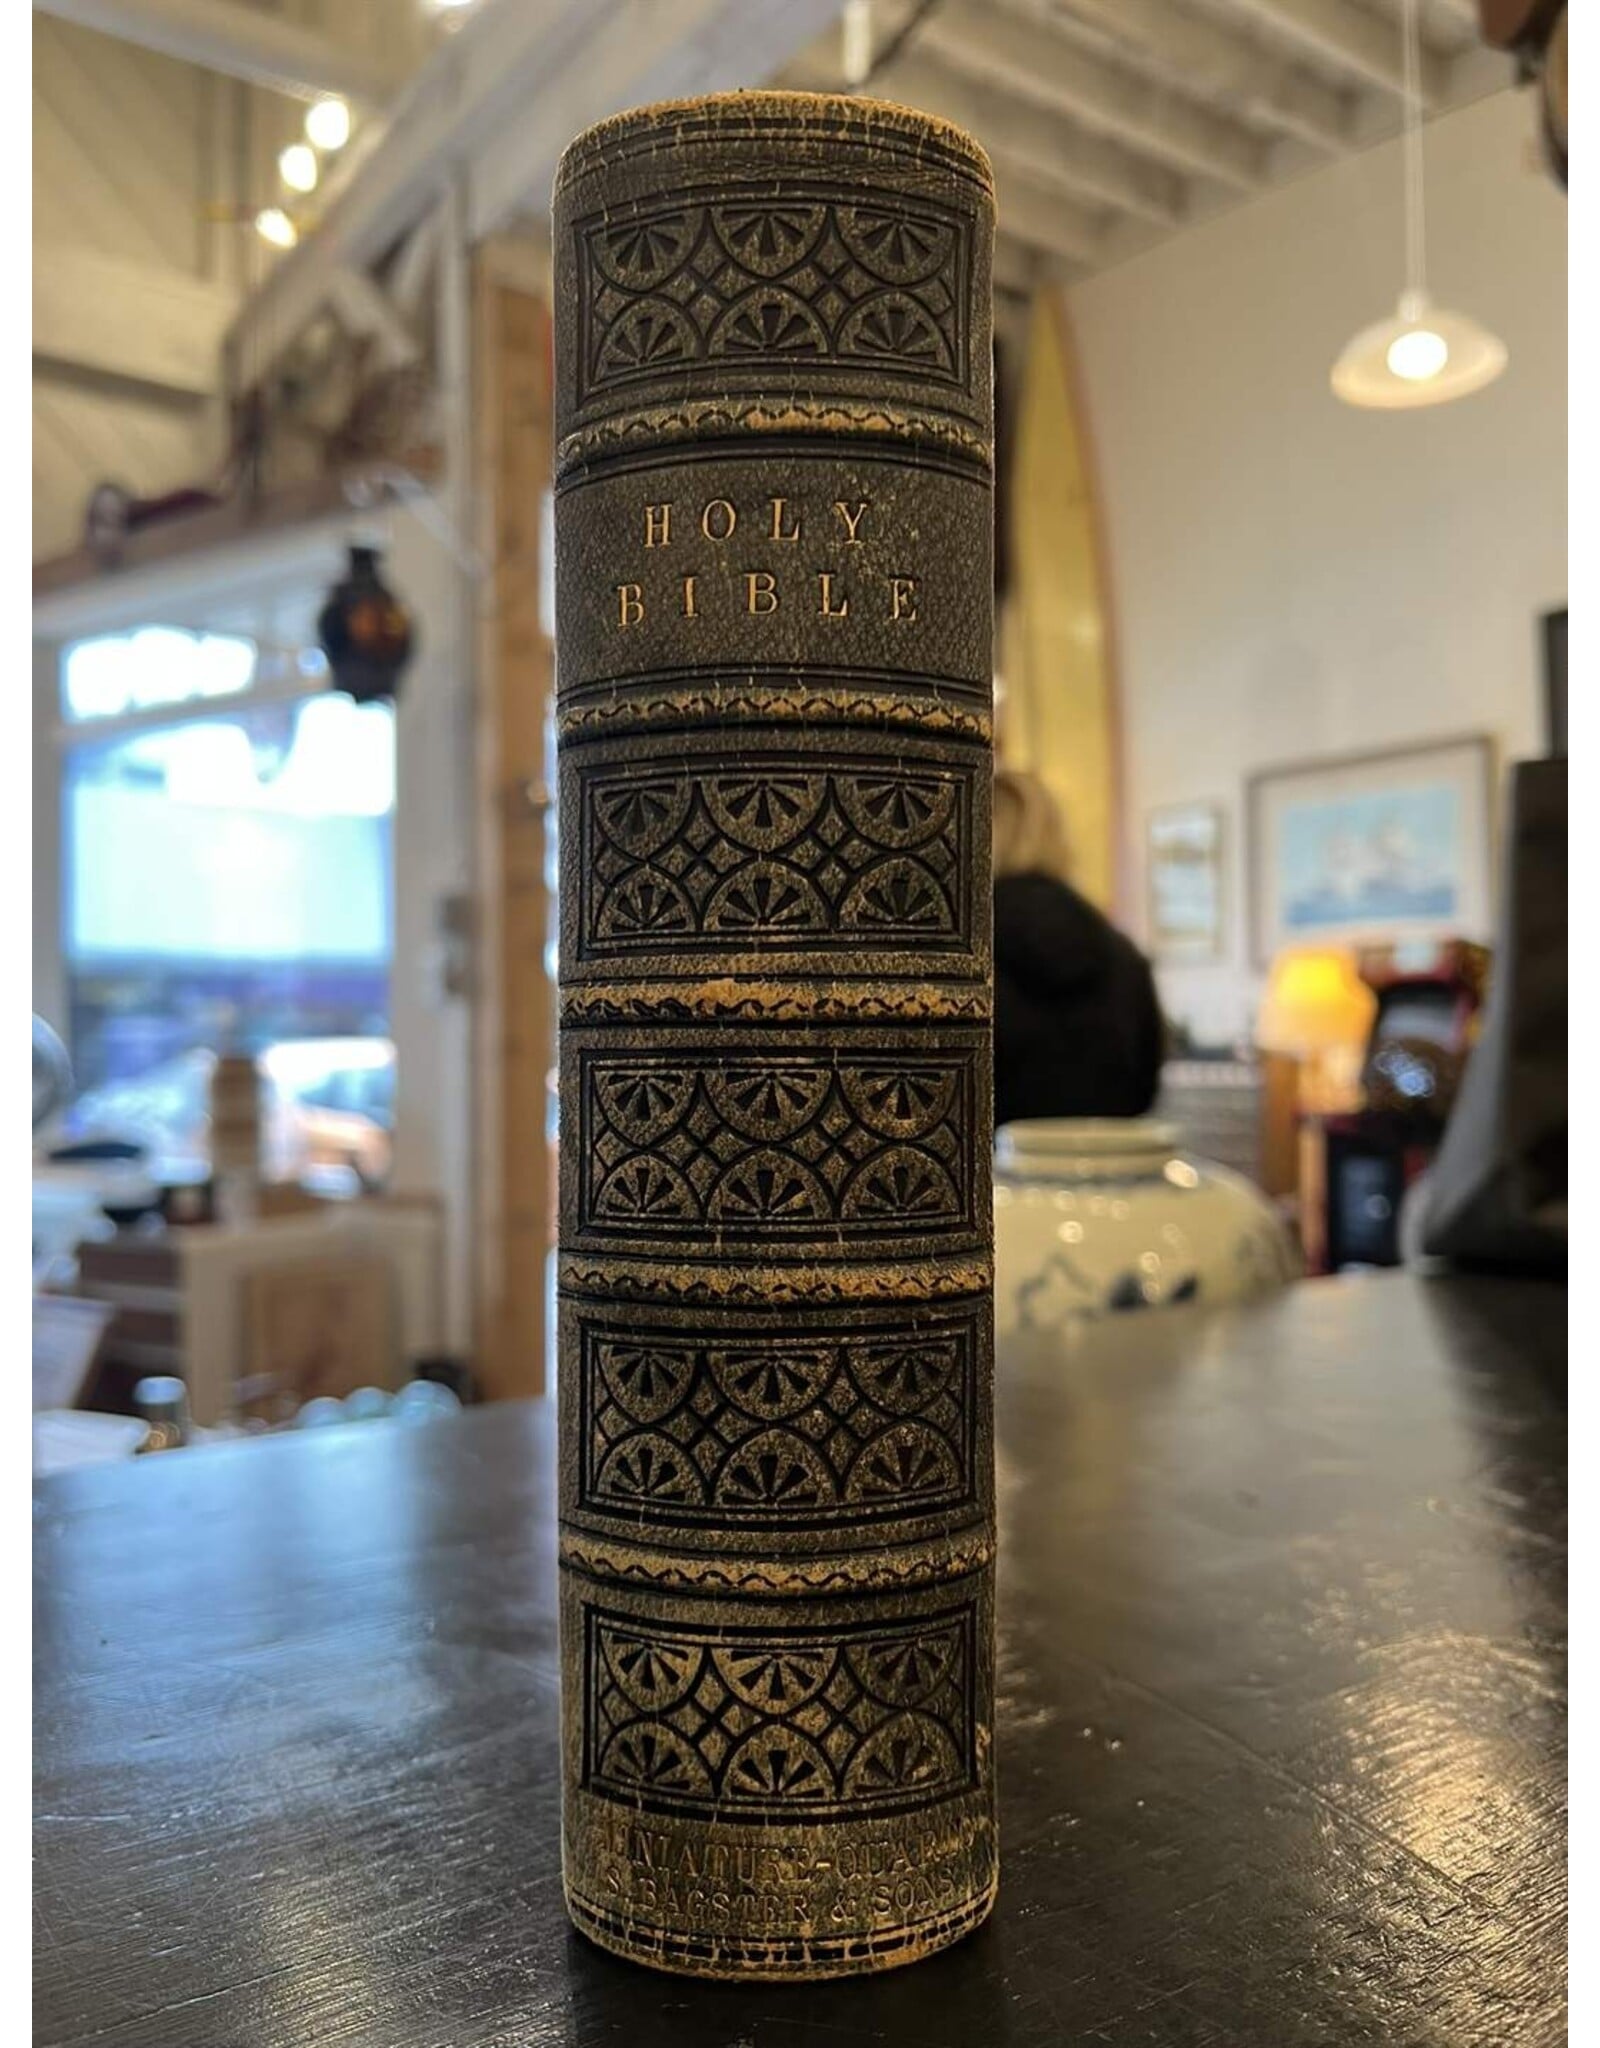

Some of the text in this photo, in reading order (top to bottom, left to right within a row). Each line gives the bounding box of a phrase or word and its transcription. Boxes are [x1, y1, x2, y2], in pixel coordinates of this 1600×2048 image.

[643, 497, 868, 549] HOLY
[616, 571, 918, 627] BIBLE
[830, 1890, 858, 1925] &
[873, 1867, 956, 1917] SONS
